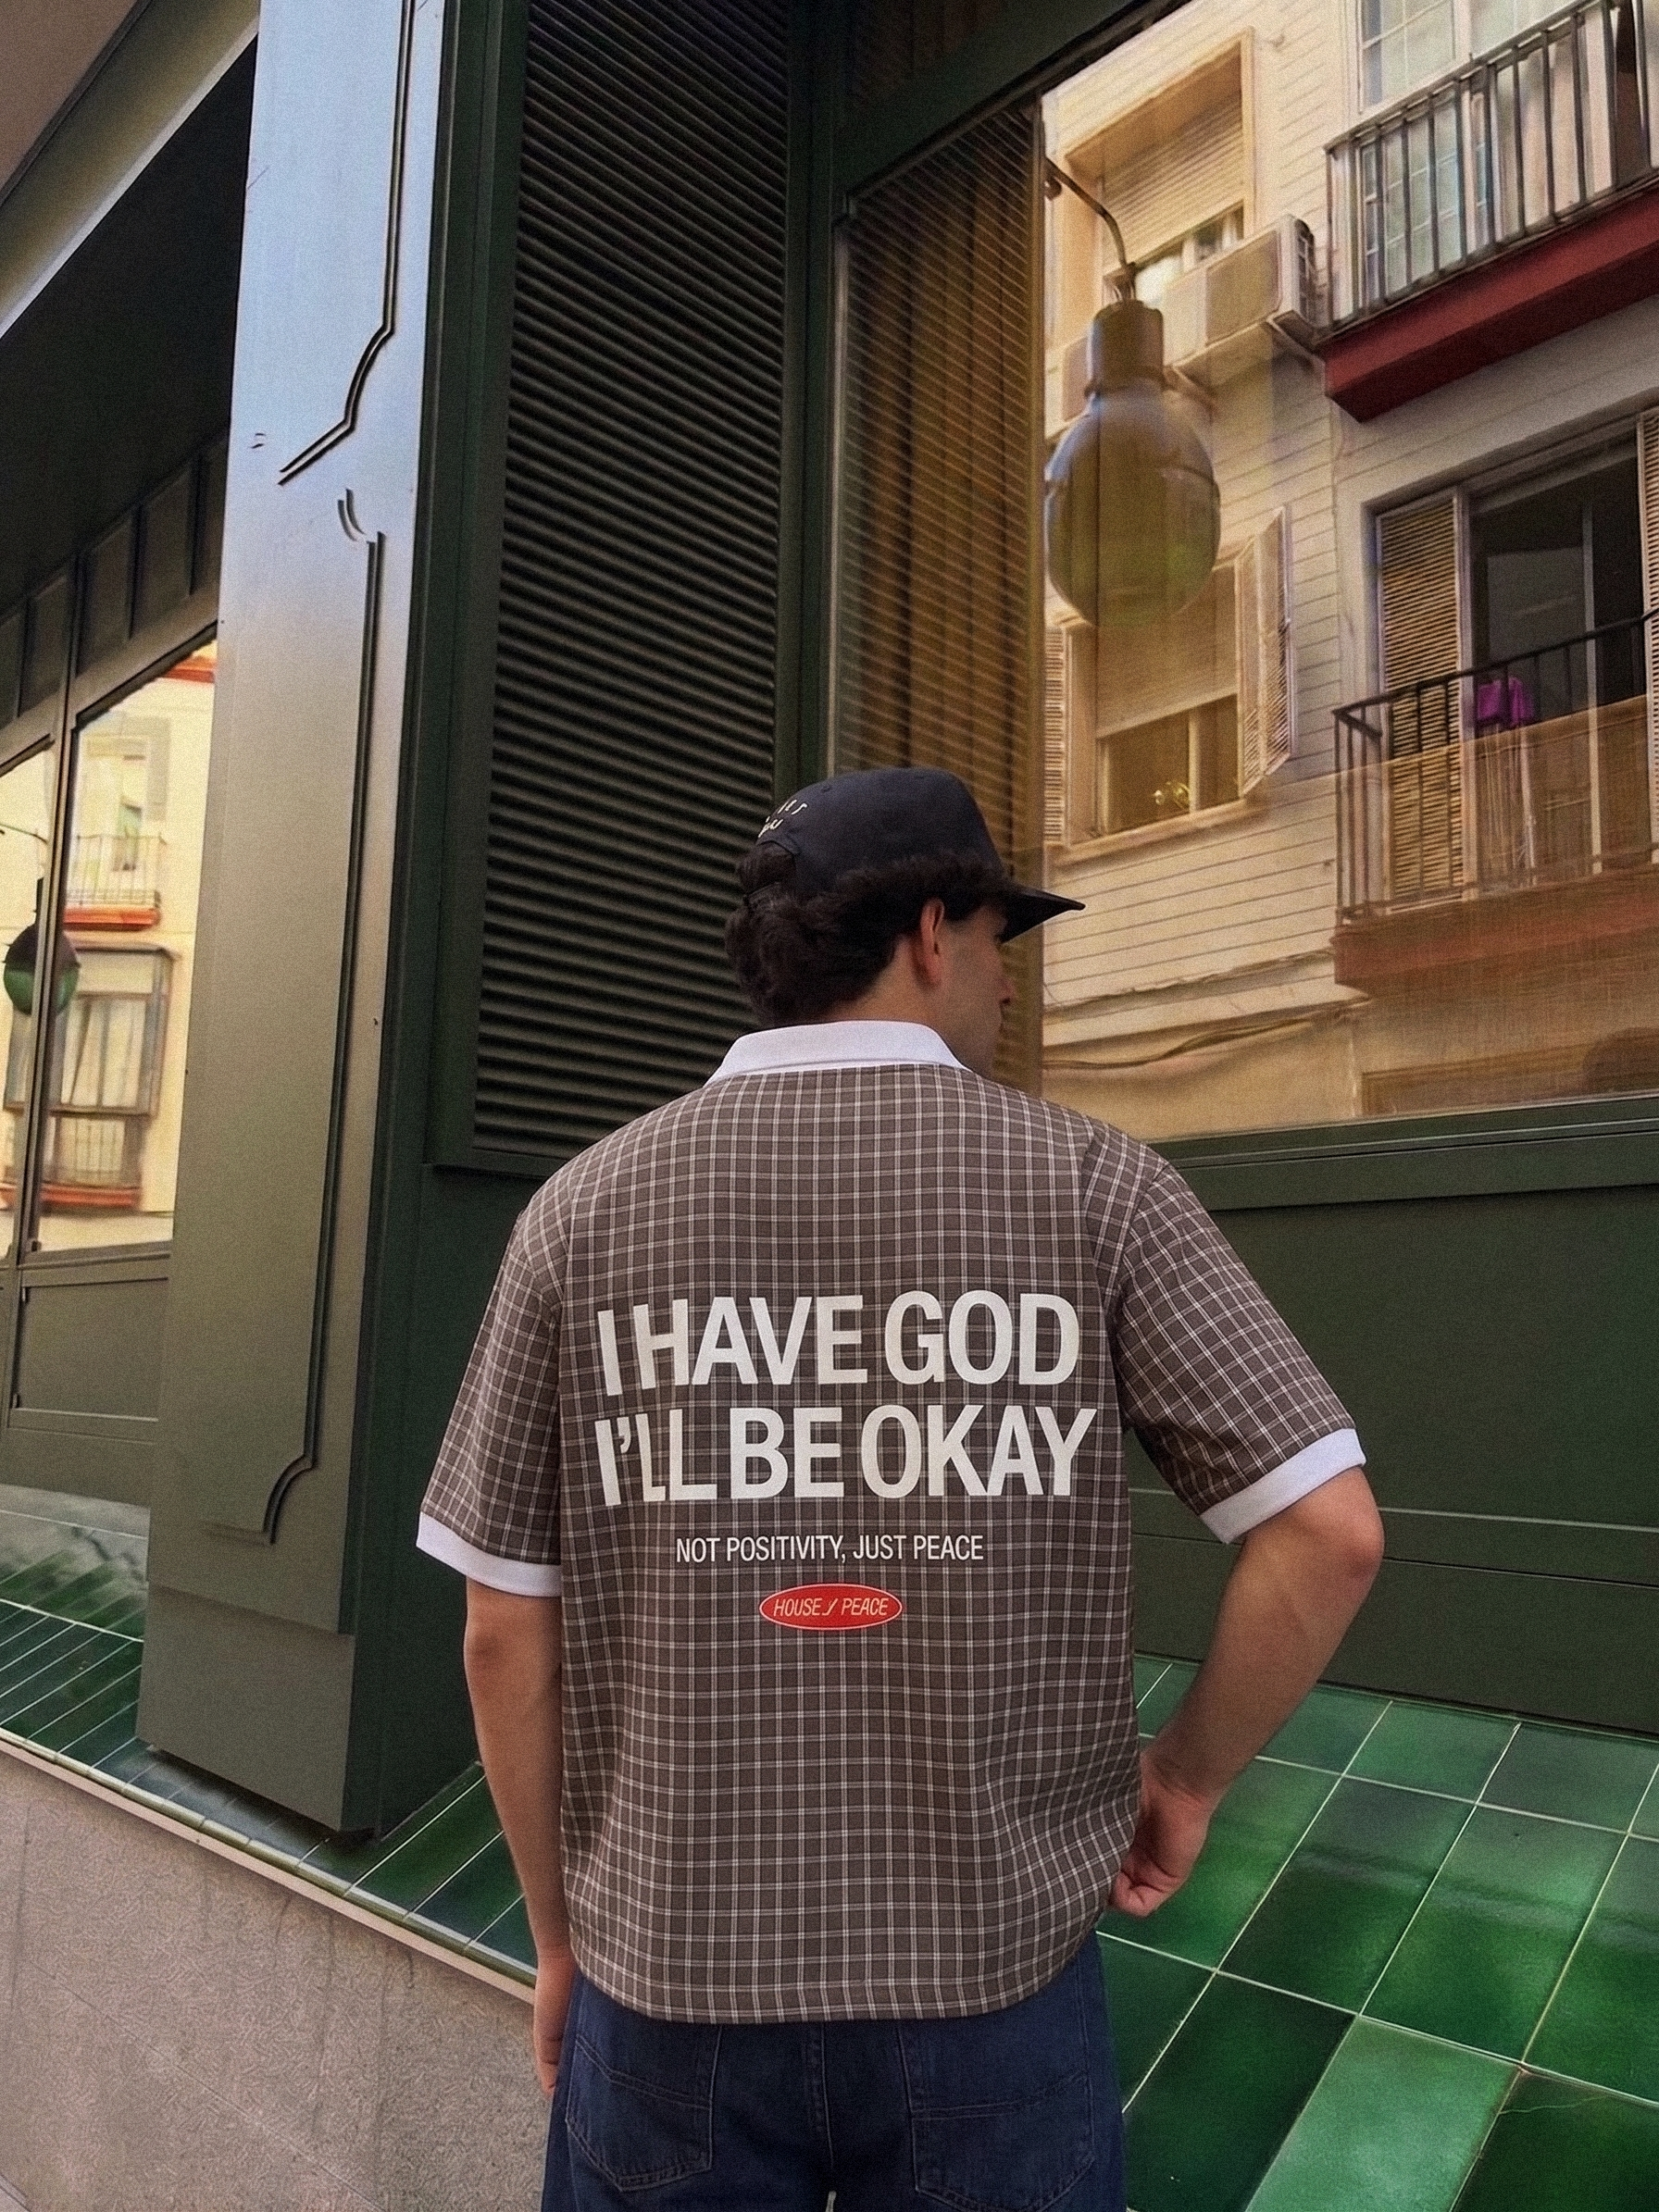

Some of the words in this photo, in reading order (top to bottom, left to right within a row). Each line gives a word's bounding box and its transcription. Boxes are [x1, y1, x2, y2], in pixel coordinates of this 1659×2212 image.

[597, 1309, 622, 1397] I
[634, 1296, 867, 1389] HAVE
[884, 1289, 1080, 1386] GOD
[594, 1408, 717, 1507] I'LL
[729, 1407, 844, 1499] BE
[860, 1404, 1098, 1498] OKAY
[676, 1536, 720, 1563] NOT
[727, 1535, 847, 1564] POSITIVITY,
[853, 1535, 907, 1560] JUST
[913, 1535, 984, 1561] PEACE
[773, 1597, 823, 1617] HOUSE
[841, 1597, 890, 1616] PEACE
